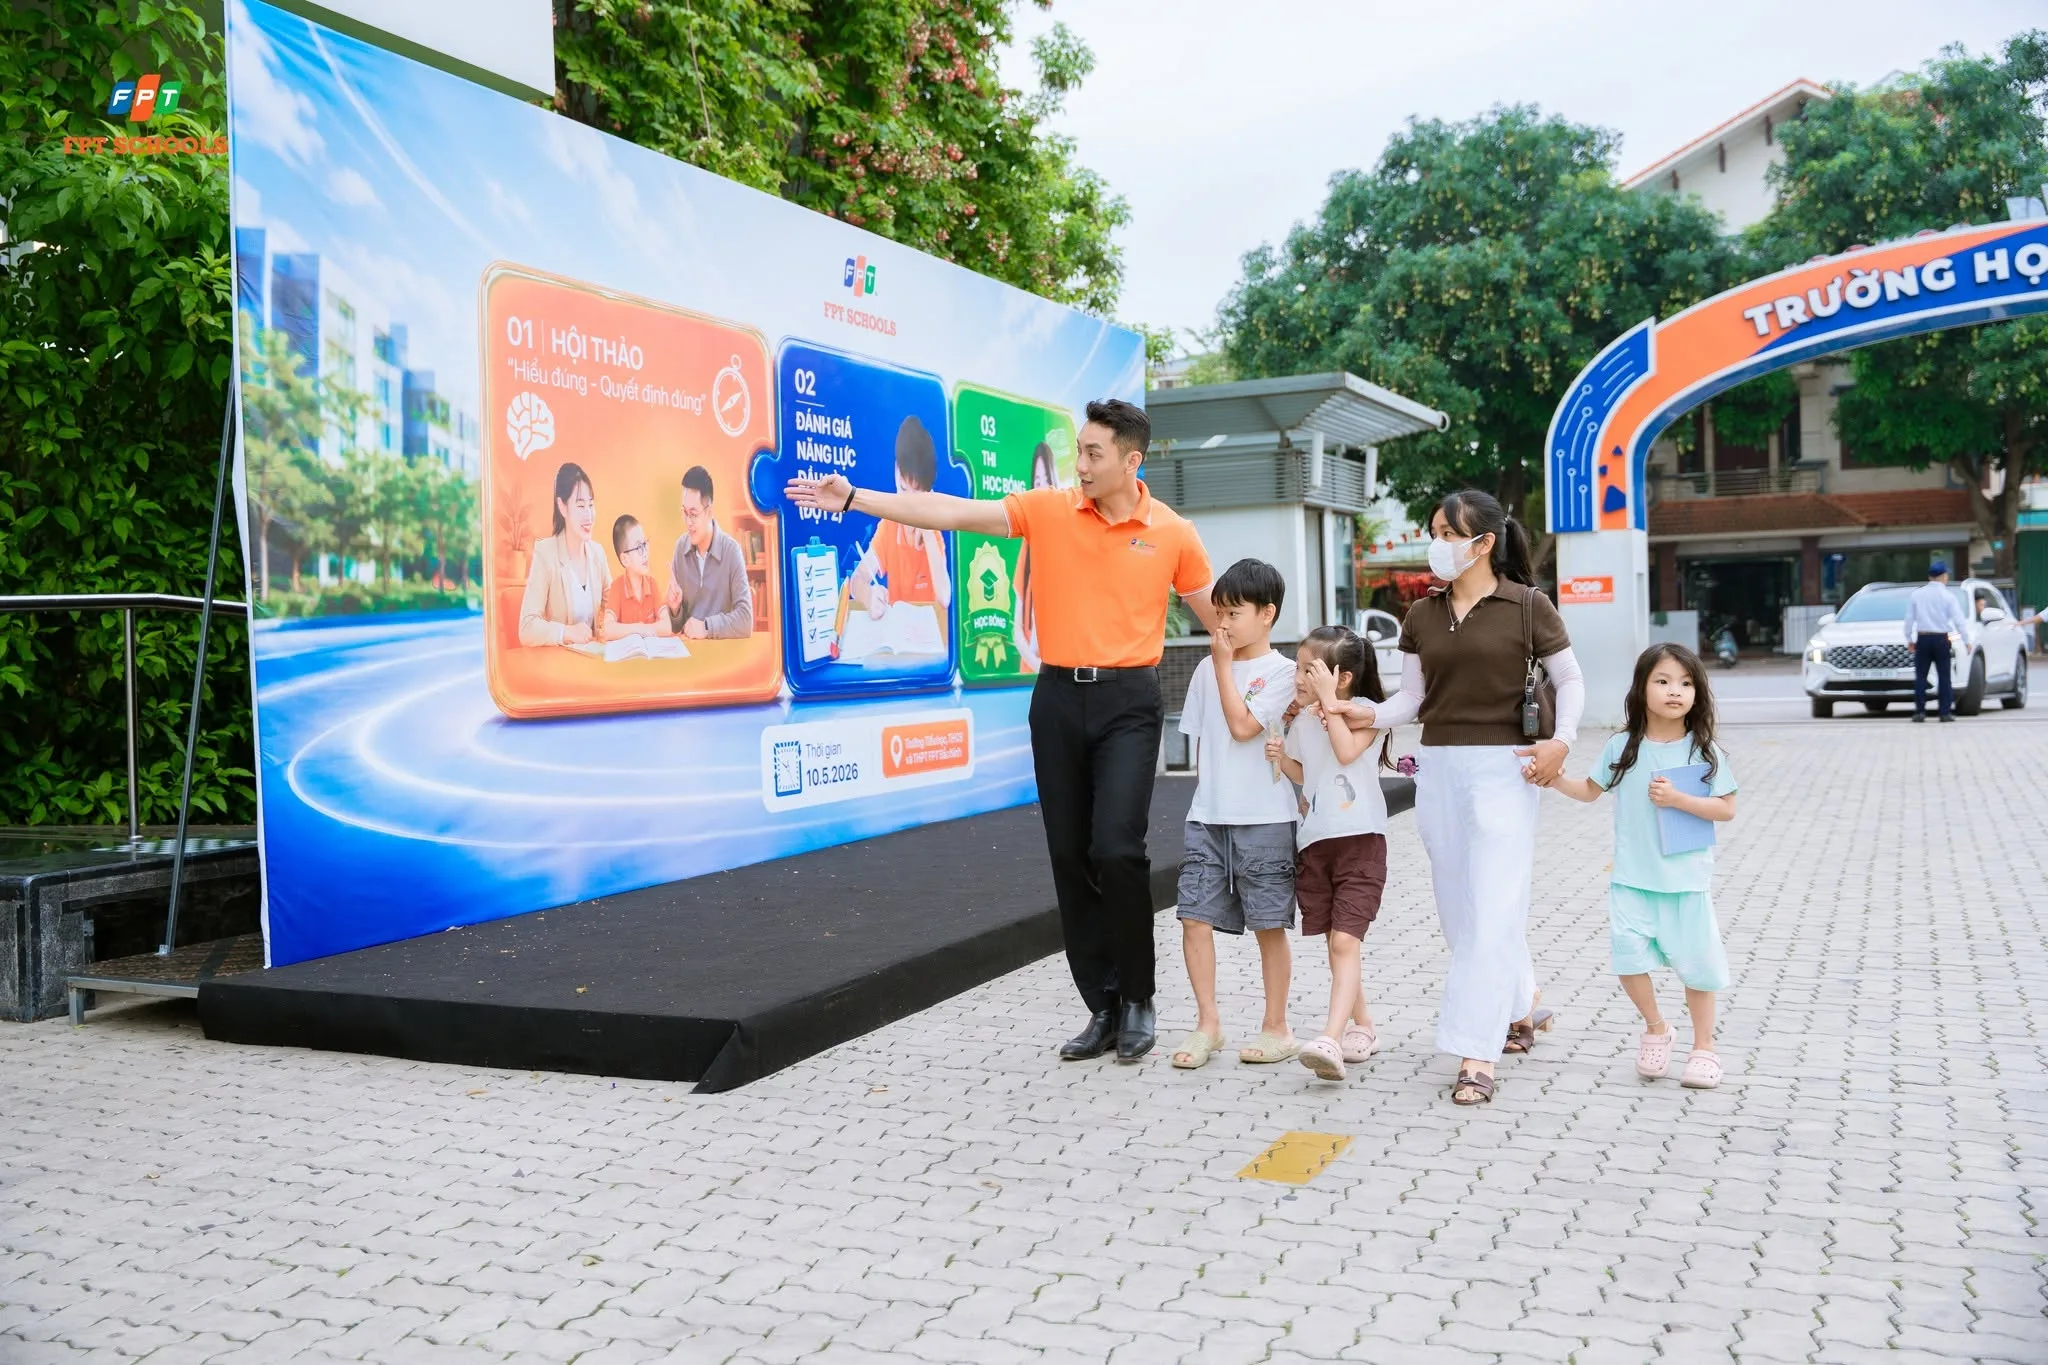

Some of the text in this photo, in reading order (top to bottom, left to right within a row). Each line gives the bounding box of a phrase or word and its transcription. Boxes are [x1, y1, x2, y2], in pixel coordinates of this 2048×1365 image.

[1744, 257, 1957, 336] TRƯỜNG
[506, 316, 533, 349] 01
[823, 301, 897, 336] FPT SCHOOLS
[551, 325, 644, 370] HỘI THẢO
[551, 367, 588, 396] đúng
[600, 376, 639, 402] Quyết
[642, 384, 669, 408] định
[794, 368, 816, 396] 02
[796, 408, 853, 440] ĐÁNH GIÁ
[980, 414, 996, 437] 03
[796, 437, 857, 470] NĂNG LỰC
[981, 449, 997, 468] THI
[982, 474, 1001, 495] HỌC
[805, 741, 842, 759] Thời gian
[806, 763, 859, 787] 10.5.2026
